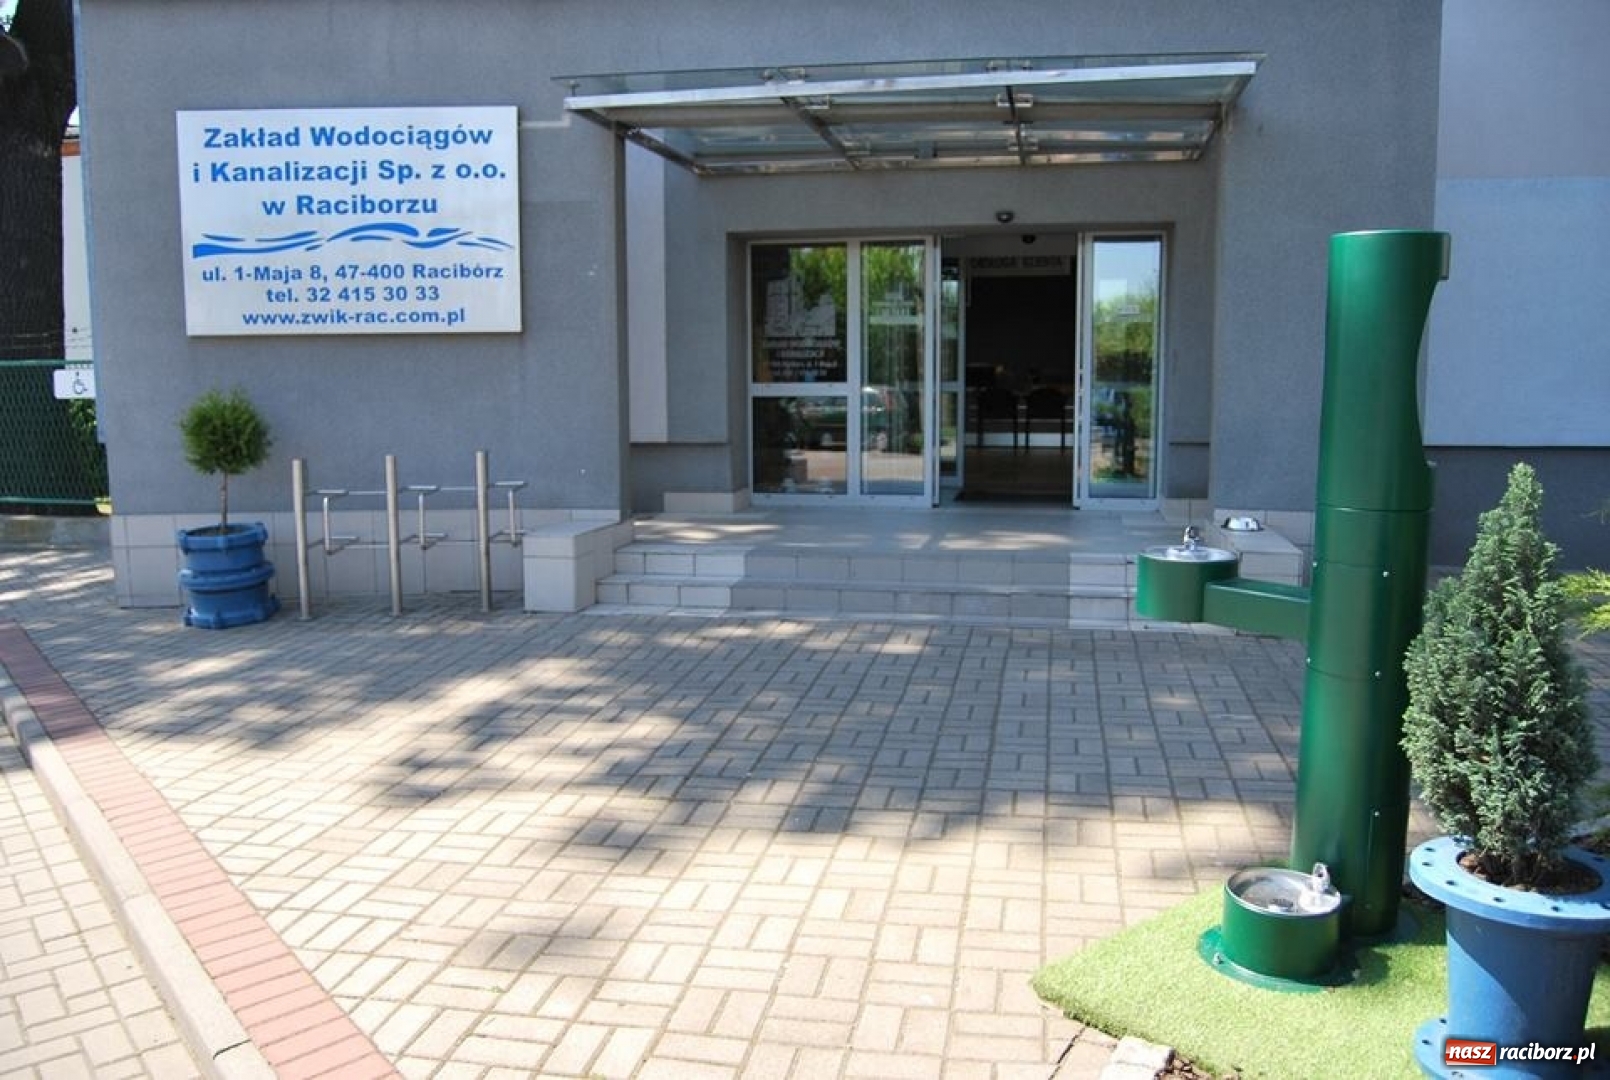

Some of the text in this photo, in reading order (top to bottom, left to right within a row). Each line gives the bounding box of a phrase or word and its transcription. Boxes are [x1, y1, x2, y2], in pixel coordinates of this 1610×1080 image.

[204, 124, 493, 150] Zakład Wodociągów
[192, 159, 506, 186] i Kanalizacji Sp. z o.o.
[261, 194, 438, 216] w Raciborzu
[202, 263, 504, 285] ul. 1-Maja 8, 47-400 Racibórz
[265, 285, 440, 303] tel. 32 415 30 33
[242, 307, 466, 326] www.zwik-rac.com.pl
